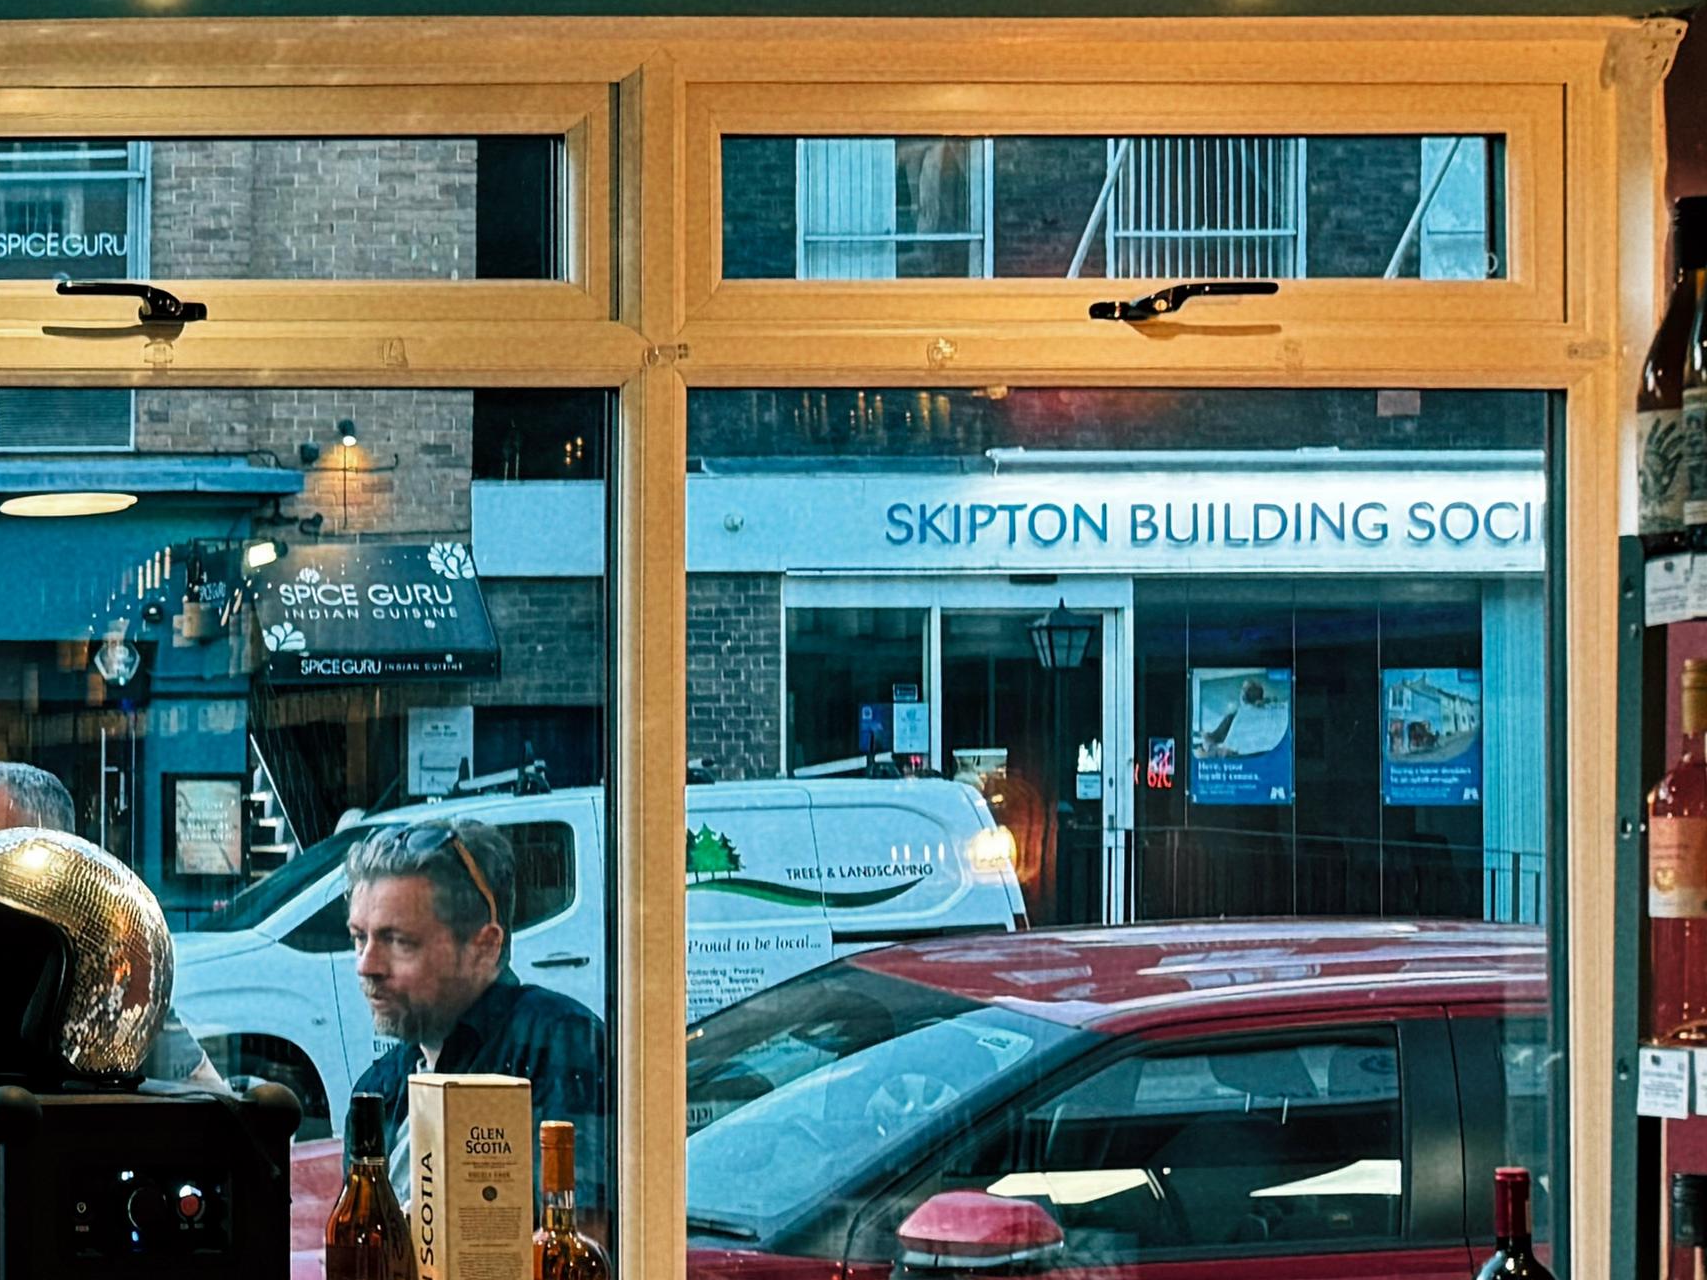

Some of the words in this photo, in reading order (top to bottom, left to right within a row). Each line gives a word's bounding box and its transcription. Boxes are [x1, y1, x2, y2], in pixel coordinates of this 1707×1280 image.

[62, 232, 127, 257] GURU
[885, 501, 1109, 546] SKIPTON
[1130, 501, 1388, 546] BUILDING
[279, 584, 359, 606] SPICE
[367, 584, 453, 606] GURU
[284, 608, 359, 619] INDIAN
[301, 658, 340, 675] SPICE
[341, 658, 381, 675] GURU
[786, 867, 822, 880] TREES
[827, 868, 835, 878] &
[840, 863, 933, 879] LANDSCAPING
[688, 937, 731, 954] Proud
[737, 937, 750, 952] to
[755, 935, 770, 951] be
[470, 1126, 505, 1140] GLEN
[466, 1140, 512, 1154] SCOTIA
[420, 1152, 434, 1266] SCOTIA
